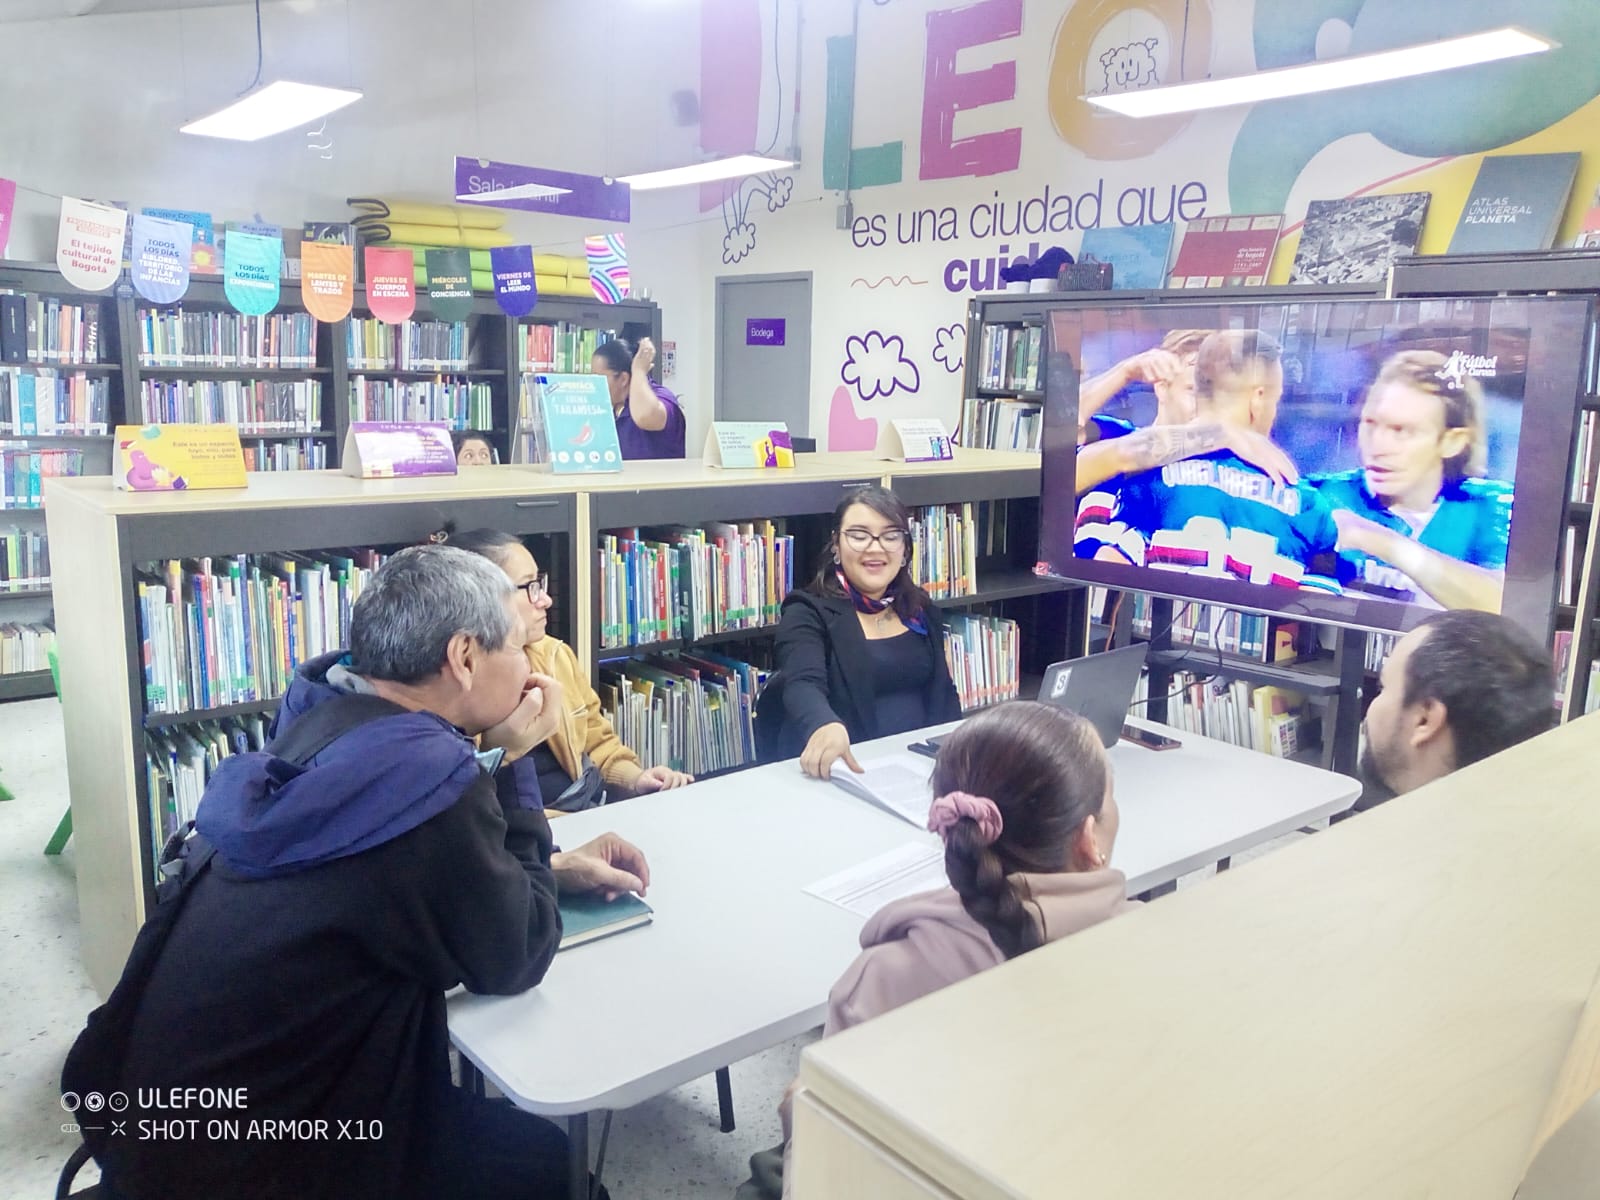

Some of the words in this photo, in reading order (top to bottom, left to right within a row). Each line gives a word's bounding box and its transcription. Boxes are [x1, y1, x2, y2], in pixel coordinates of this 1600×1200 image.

[1471, 197, 1510, 206] ATLAS
[851, 214, 887, 248] es
[897, 204, 958, 245] una
[969, 178, 1103, 239] ciudad
[1116, 181, 1208, 227] que
[1468, 205, 1533, 215] UNIVERSAL
[1464, 215, 1517, 224] PLANETA
[71, 239, 81, 248] El
[83, 242, 112, 255] tejido
[148, 239, 175, 249] TODOS
[62, 248, 102, 263] cultural
[103, 256, 116, 266] de
[144, 246, 159, 254] LOS
[160, 247, 180, 258] DÍAS
[71, 259, 107, 274] Bogotá
[239, 263, 265, 273] TODOS
[235, 271, 250, 279] LOS
[251, 272, 270, 281] DÍAS
[431, 275, 467, 284] MIÉRCOLES
[496, 271, 522, 281] VIERNES
[522, 271, 532, 279] DE
[374, 283, 407, 291] CUERPOS
[500, 286, 508, 294] EL
[508, 284, 532, 293] MUNDO
[383, 290, 410, 298] ESCENA
[430, 290, 471, 298] CONCIENCIA
[751, 327, 774, 340] Bodega
